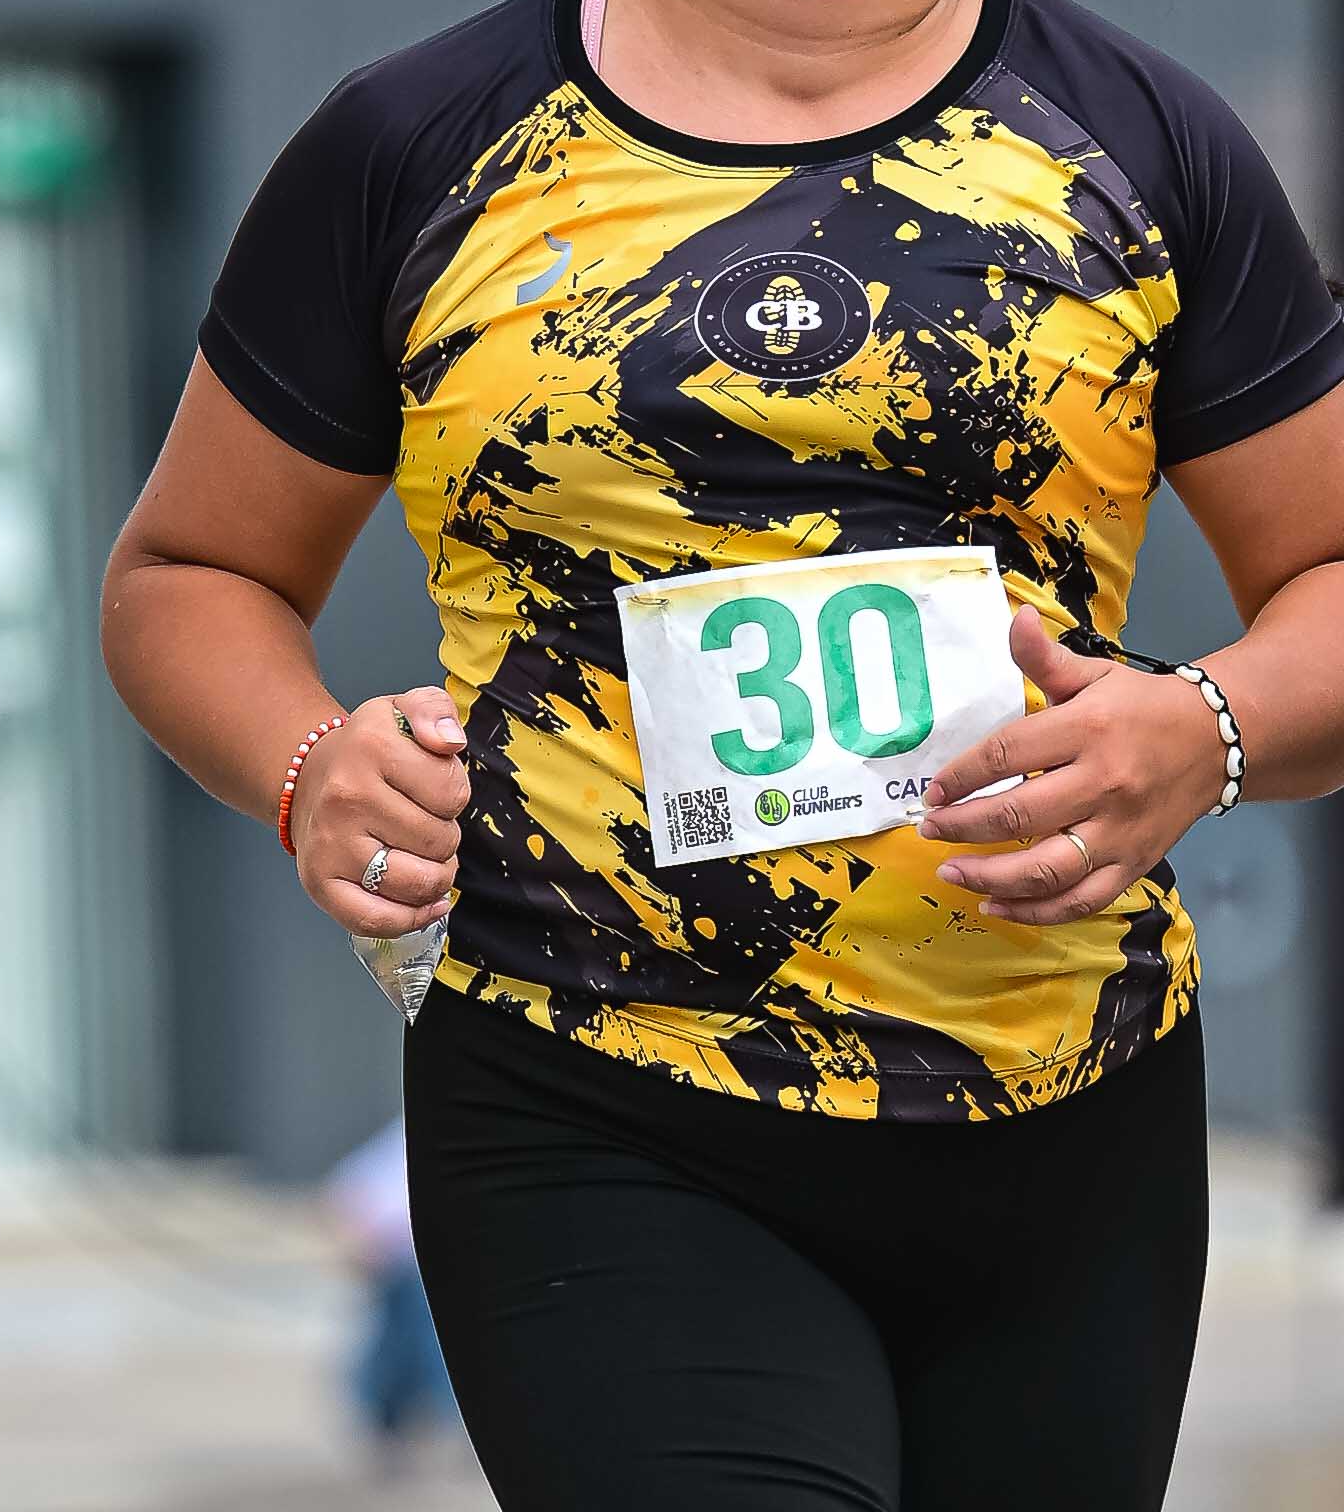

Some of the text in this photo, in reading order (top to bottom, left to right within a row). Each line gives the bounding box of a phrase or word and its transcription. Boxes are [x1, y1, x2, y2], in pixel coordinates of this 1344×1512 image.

[745, 299, 823, 332] CB
[699, 583, 935, 777] 30
[792, 786, 829, 803] CLUB
[792, 794, 863, 817] RUNNER'S
